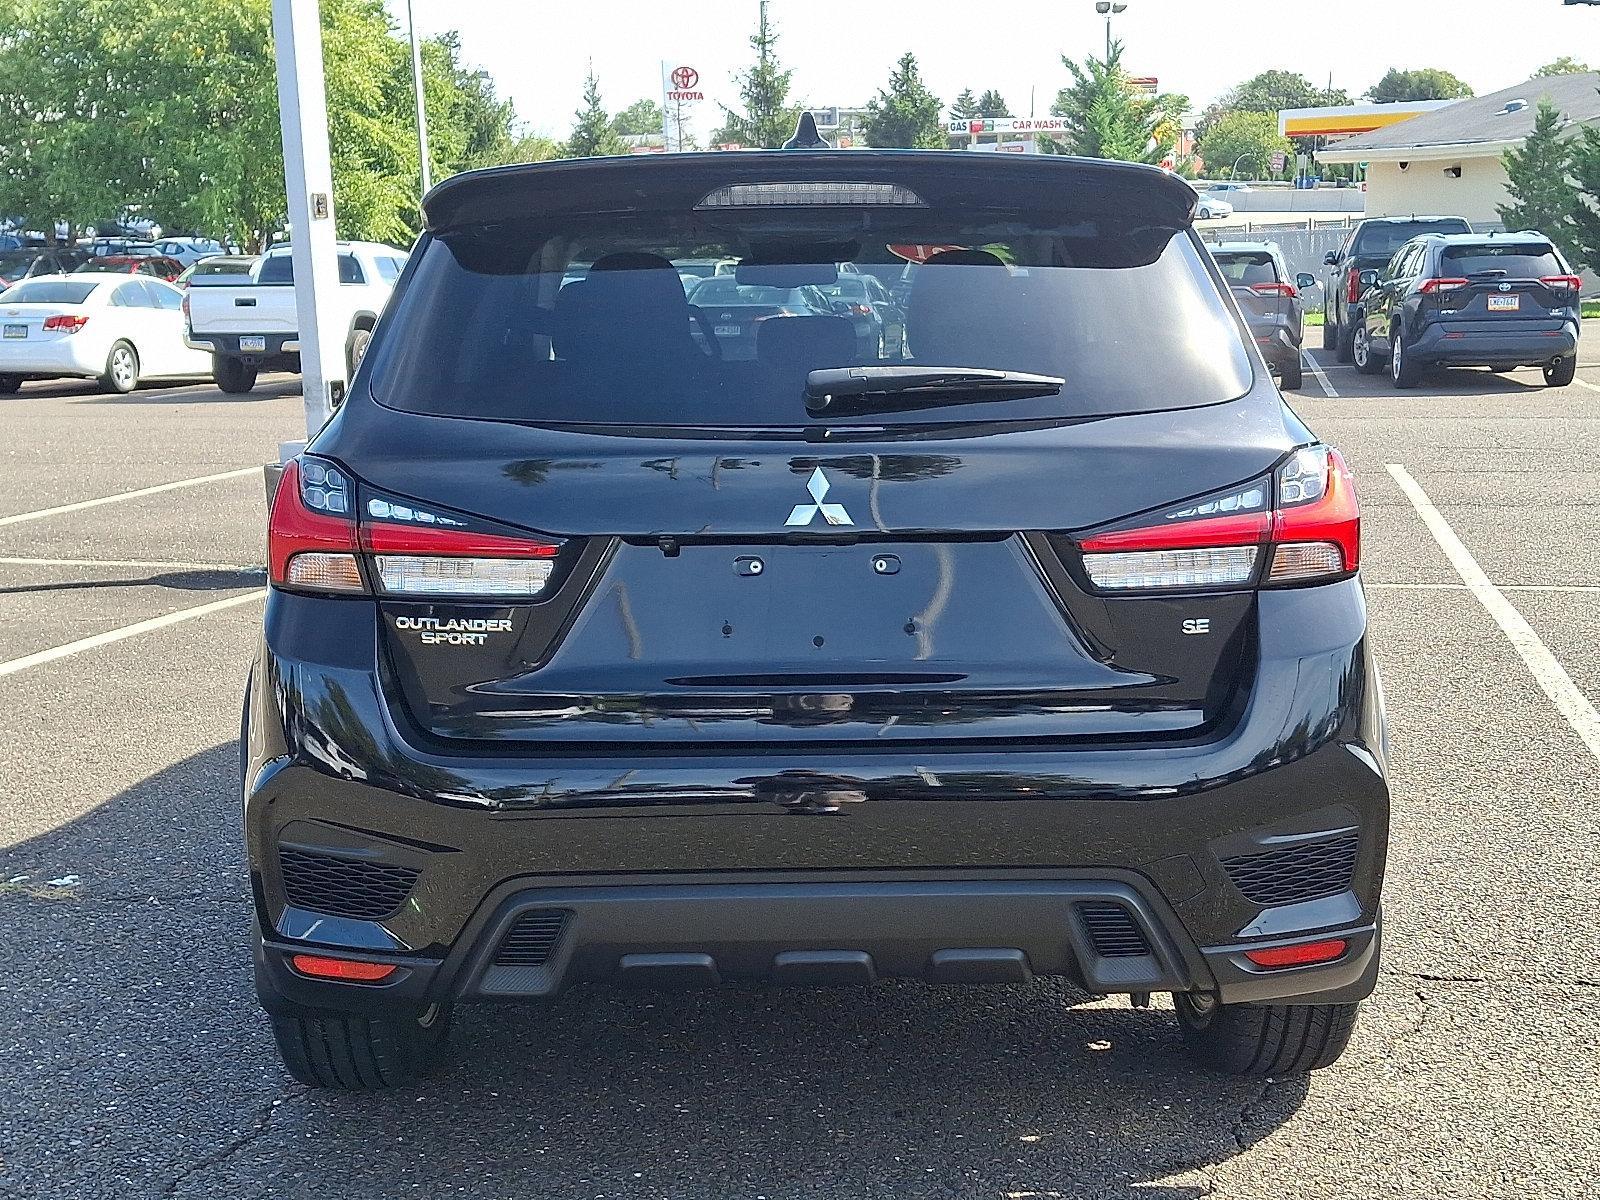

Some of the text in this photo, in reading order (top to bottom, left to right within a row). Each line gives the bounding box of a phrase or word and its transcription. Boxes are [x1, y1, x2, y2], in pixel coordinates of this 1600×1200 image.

[666, 91, 704, 101] TOYOTA
[949, 119, 1061, 131] GAS CAR WASH
[395, 616, 513, 632] OUTLANDER
[1181, 618, 1210, 634] SE
[420, 631, 488, 645] SPORT
